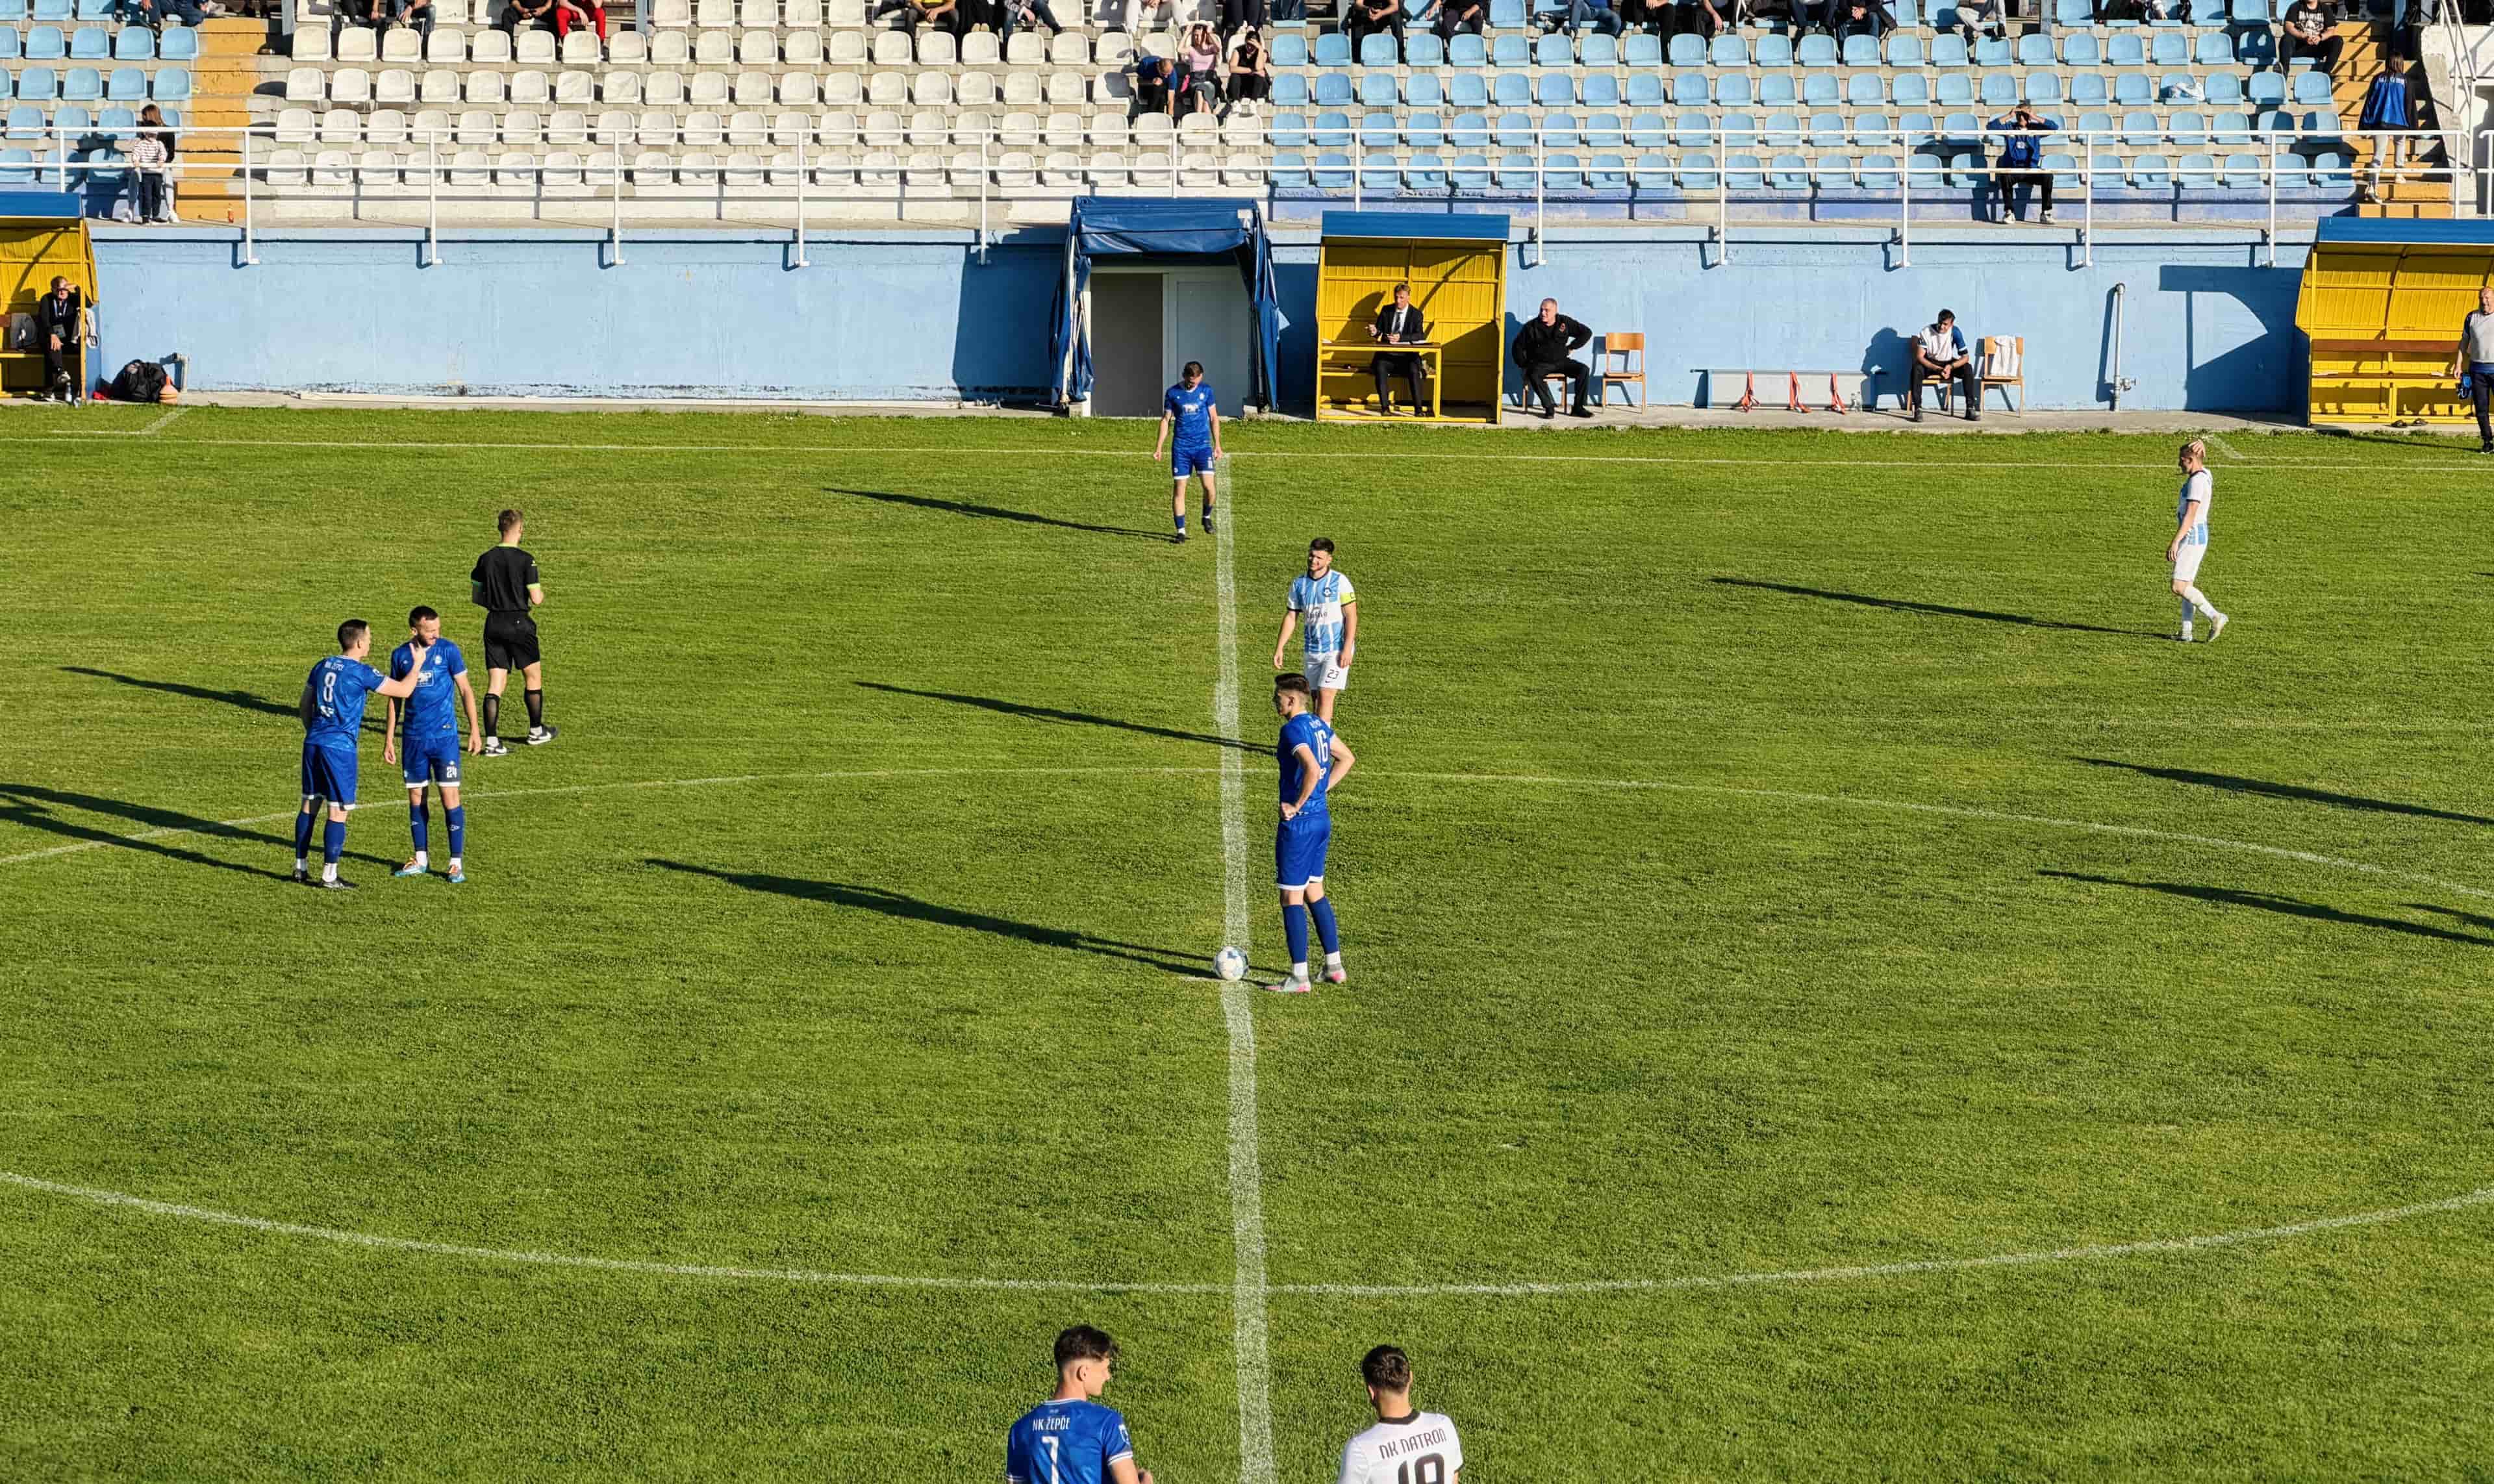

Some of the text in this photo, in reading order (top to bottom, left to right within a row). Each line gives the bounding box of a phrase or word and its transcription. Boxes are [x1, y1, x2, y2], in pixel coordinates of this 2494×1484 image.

[1326, 670, 1340, 680] 23
[323, 672, 337, 703] 8
[1314, 729, 1329, 763] 16
[446, 767, 458, 778] 24
[1033, 1418, 1044, 1431] NK
[1379, 1427, 1448, 1460] NK NATRON
